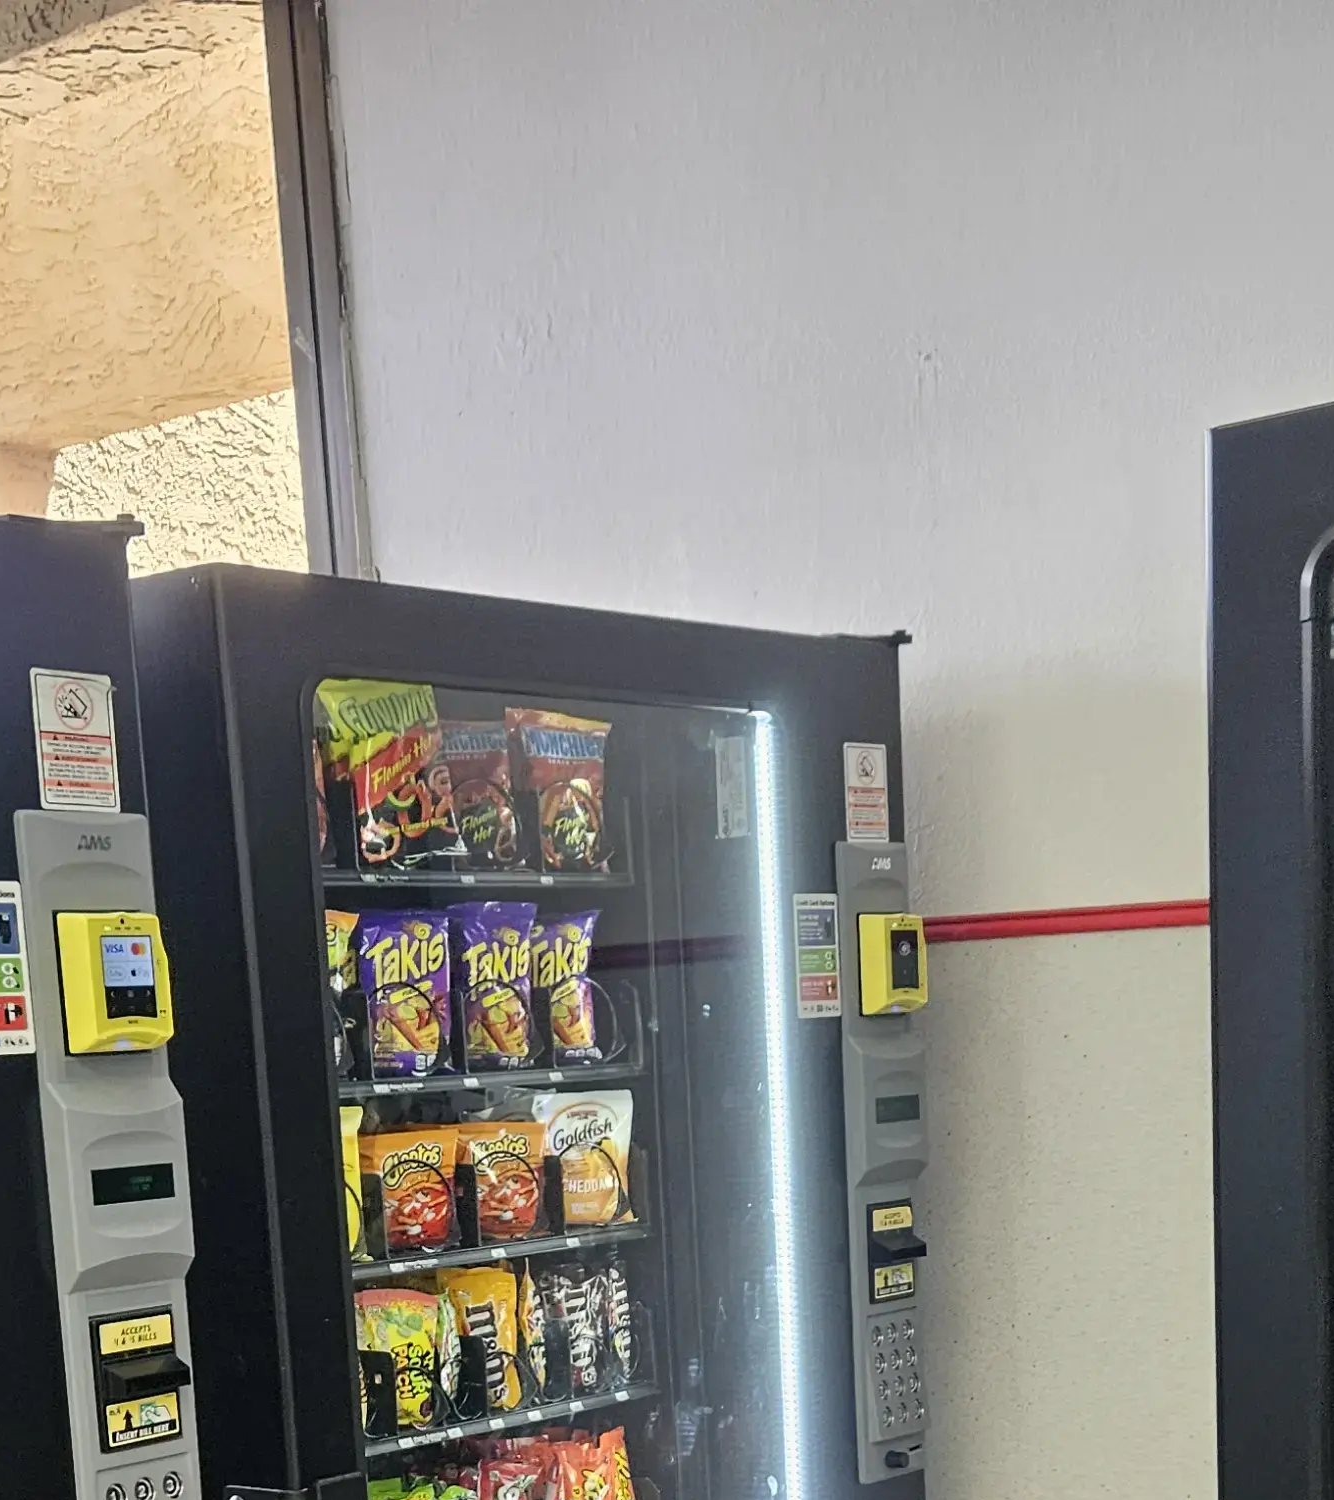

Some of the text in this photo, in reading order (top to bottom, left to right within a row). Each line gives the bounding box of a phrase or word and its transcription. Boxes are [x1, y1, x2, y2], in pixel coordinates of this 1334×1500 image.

[77, 834, 112, 851] AMS
[104, 944, 124, 954] VISA
[366, 930, 445, 988] Takis
[462, 935, 532, 990] Takis
[532, 934, 592, 988] Takis
[553, 1117, 614, 1151] Goldfish
[382, 1145, 442, 1187] Cheetos
[121, 1324, 151, 1336] ACCEPTS
[138, 1331, 157, 1342] BILLS
[392, 1343, 415, 1400] PATCH
[408, 1343, 428, 1396] SOUR
[115, 1429, 138, 1443] INSERT
